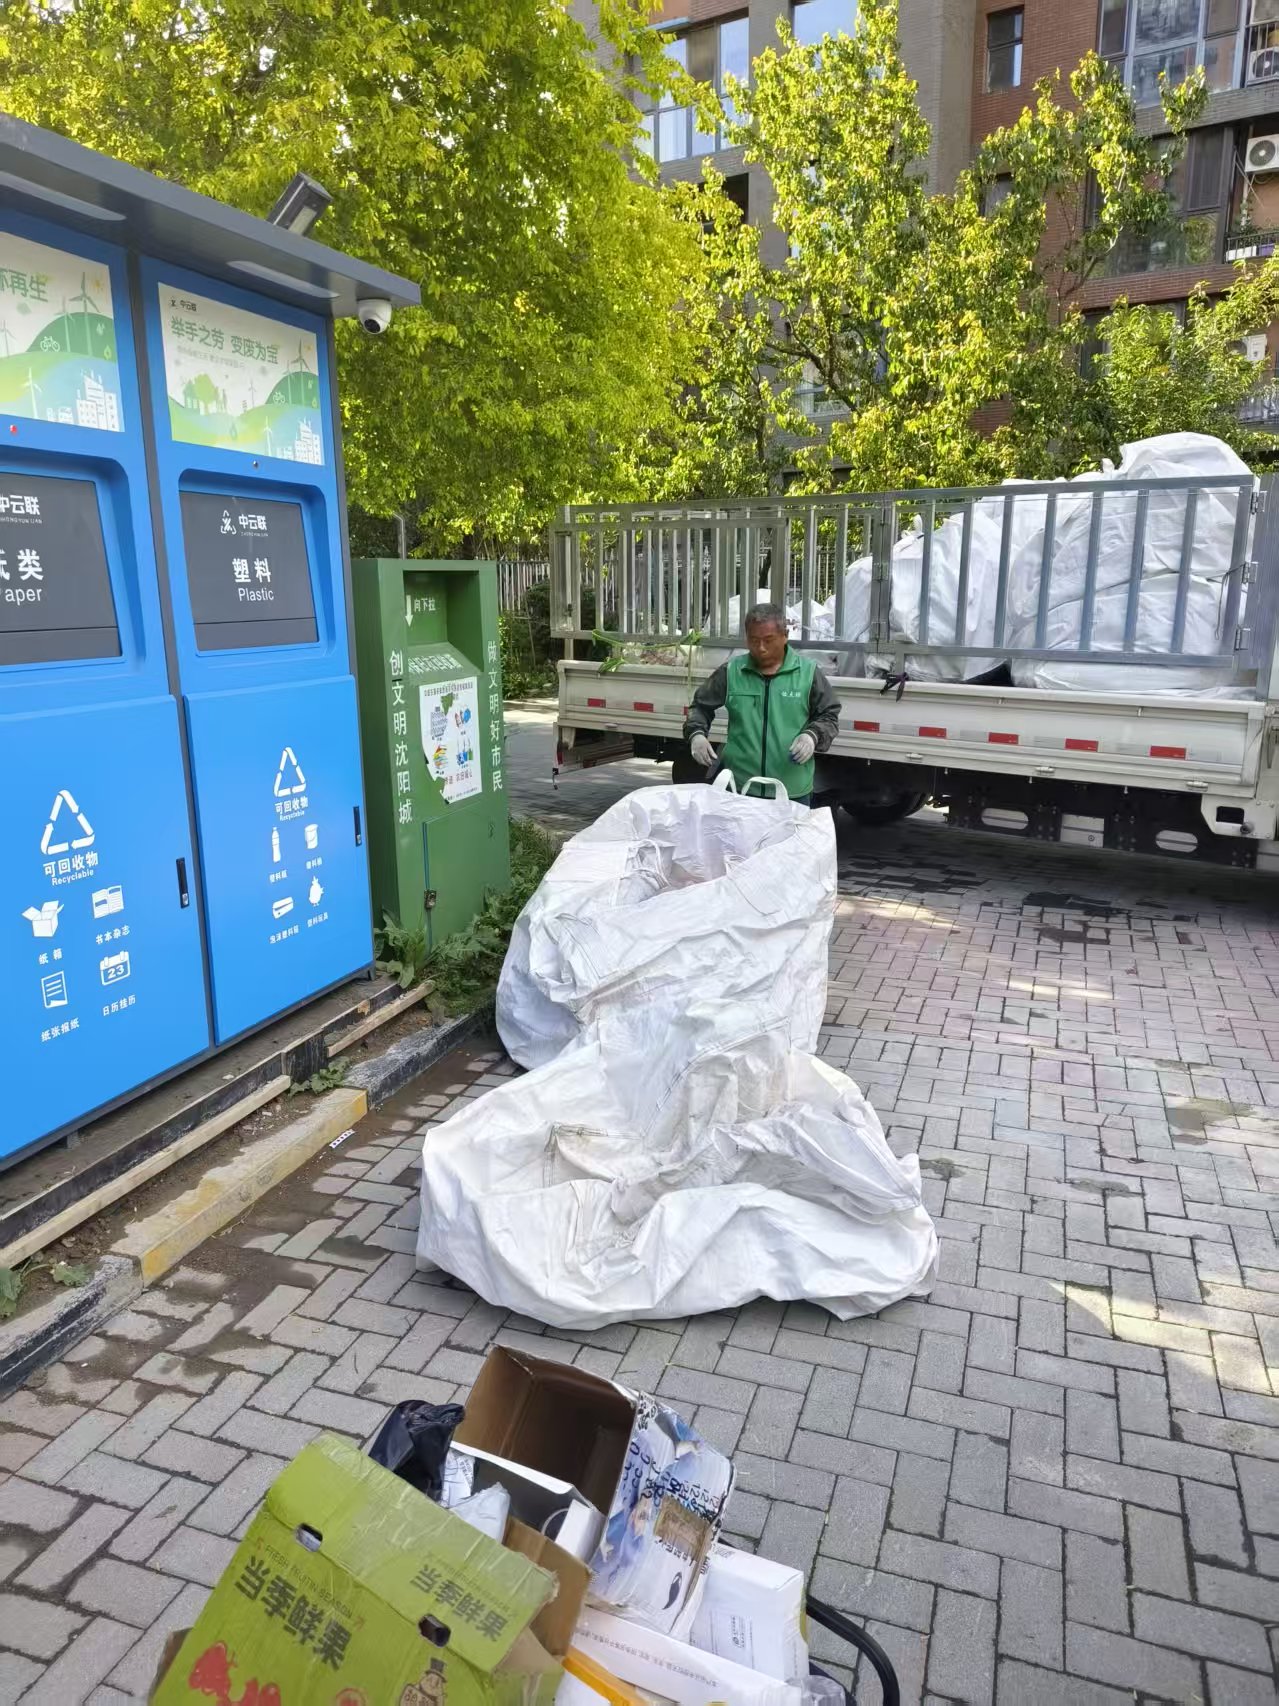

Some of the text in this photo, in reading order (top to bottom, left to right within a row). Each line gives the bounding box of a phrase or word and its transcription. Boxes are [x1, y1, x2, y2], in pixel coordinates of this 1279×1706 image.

[170, 316, 225, 350] 举手之劳
[230, 335, 279, 365] 变废为宝
[238, 513, 268, 531] 中云联
[232, 557, 272, 583] 塑料
[0, 588, 42, 606] aper
[238, 587, 275, 602] Plastic
[487, 641, 503, 792] 做文明好市民
[389, 649, 413, 825] 创文明沈阳城
[274, 795, 309, 815] 可回收物
[280, 809, 305, 822] Recyclable
[43, 851, 99, 878] 可回收物
[51, 869, 94, 886] Recyclable
[95, 925, 130, 945] 书本杂志
[107, 964, 125, 980] 23
[103, 994, 136, 1017] 日历挂历
[41, 1017, 80, 1042] 纸张报纸
[234, 1555, 352, 1671] 当季鲜果
[409, 1563, 509, 1642] 当季鲜果
